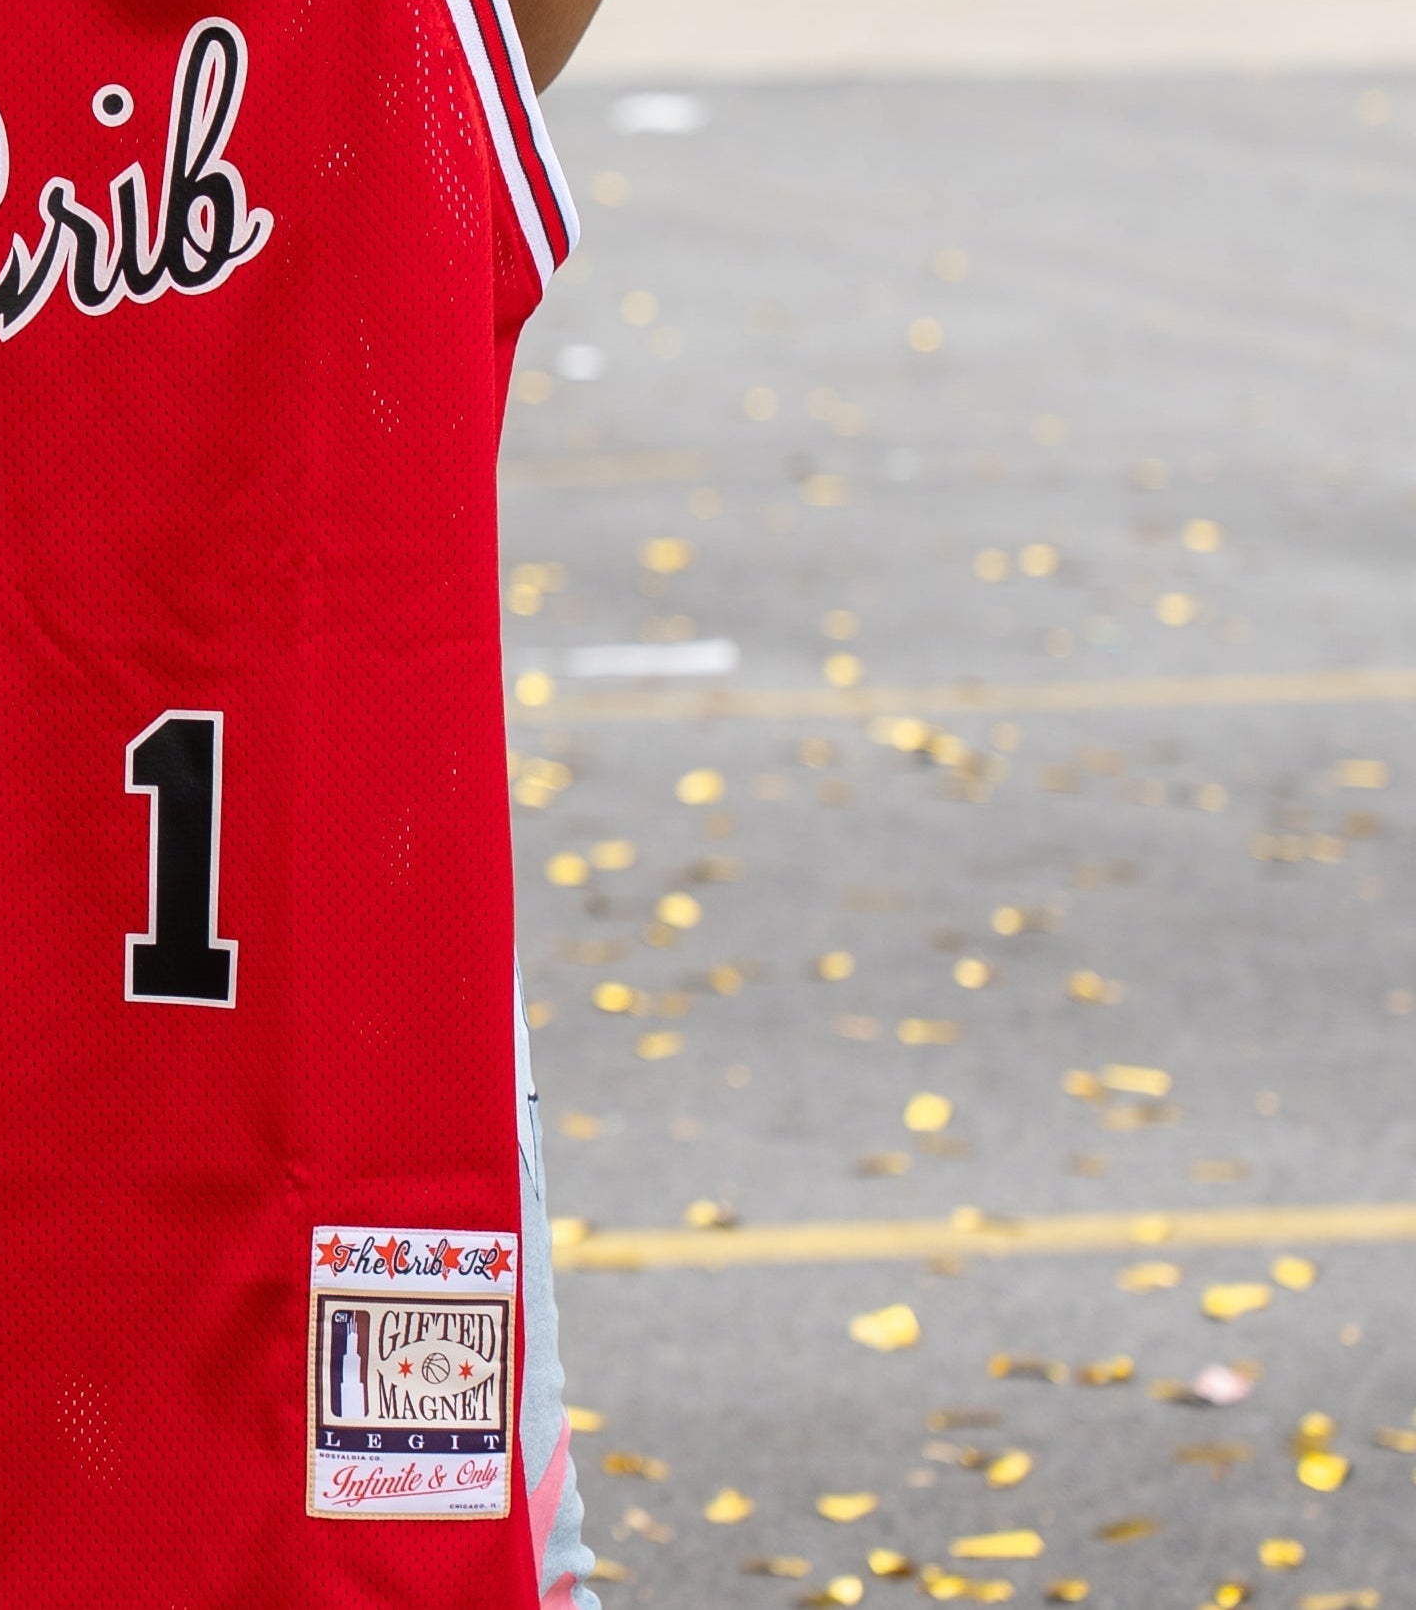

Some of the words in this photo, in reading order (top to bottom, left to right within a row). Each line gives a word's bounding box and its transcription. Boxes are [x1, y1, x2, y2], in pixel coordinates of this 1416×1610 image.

[125, 709, 238, 1009] 1
[334, 1236, 388, 1275] The
[459, 1248, 499, 1281] IL
[377, 1310, 497, 1363] GIFTED
[376, 1368, 495, 1422] MAGNET
[325, 1431, 500, 1450] LEGIT
[323, 1462, 422, 1508] Infinite
[428, 1465, 447, 1489] &
[457, 1459, 499, 1491] Only
